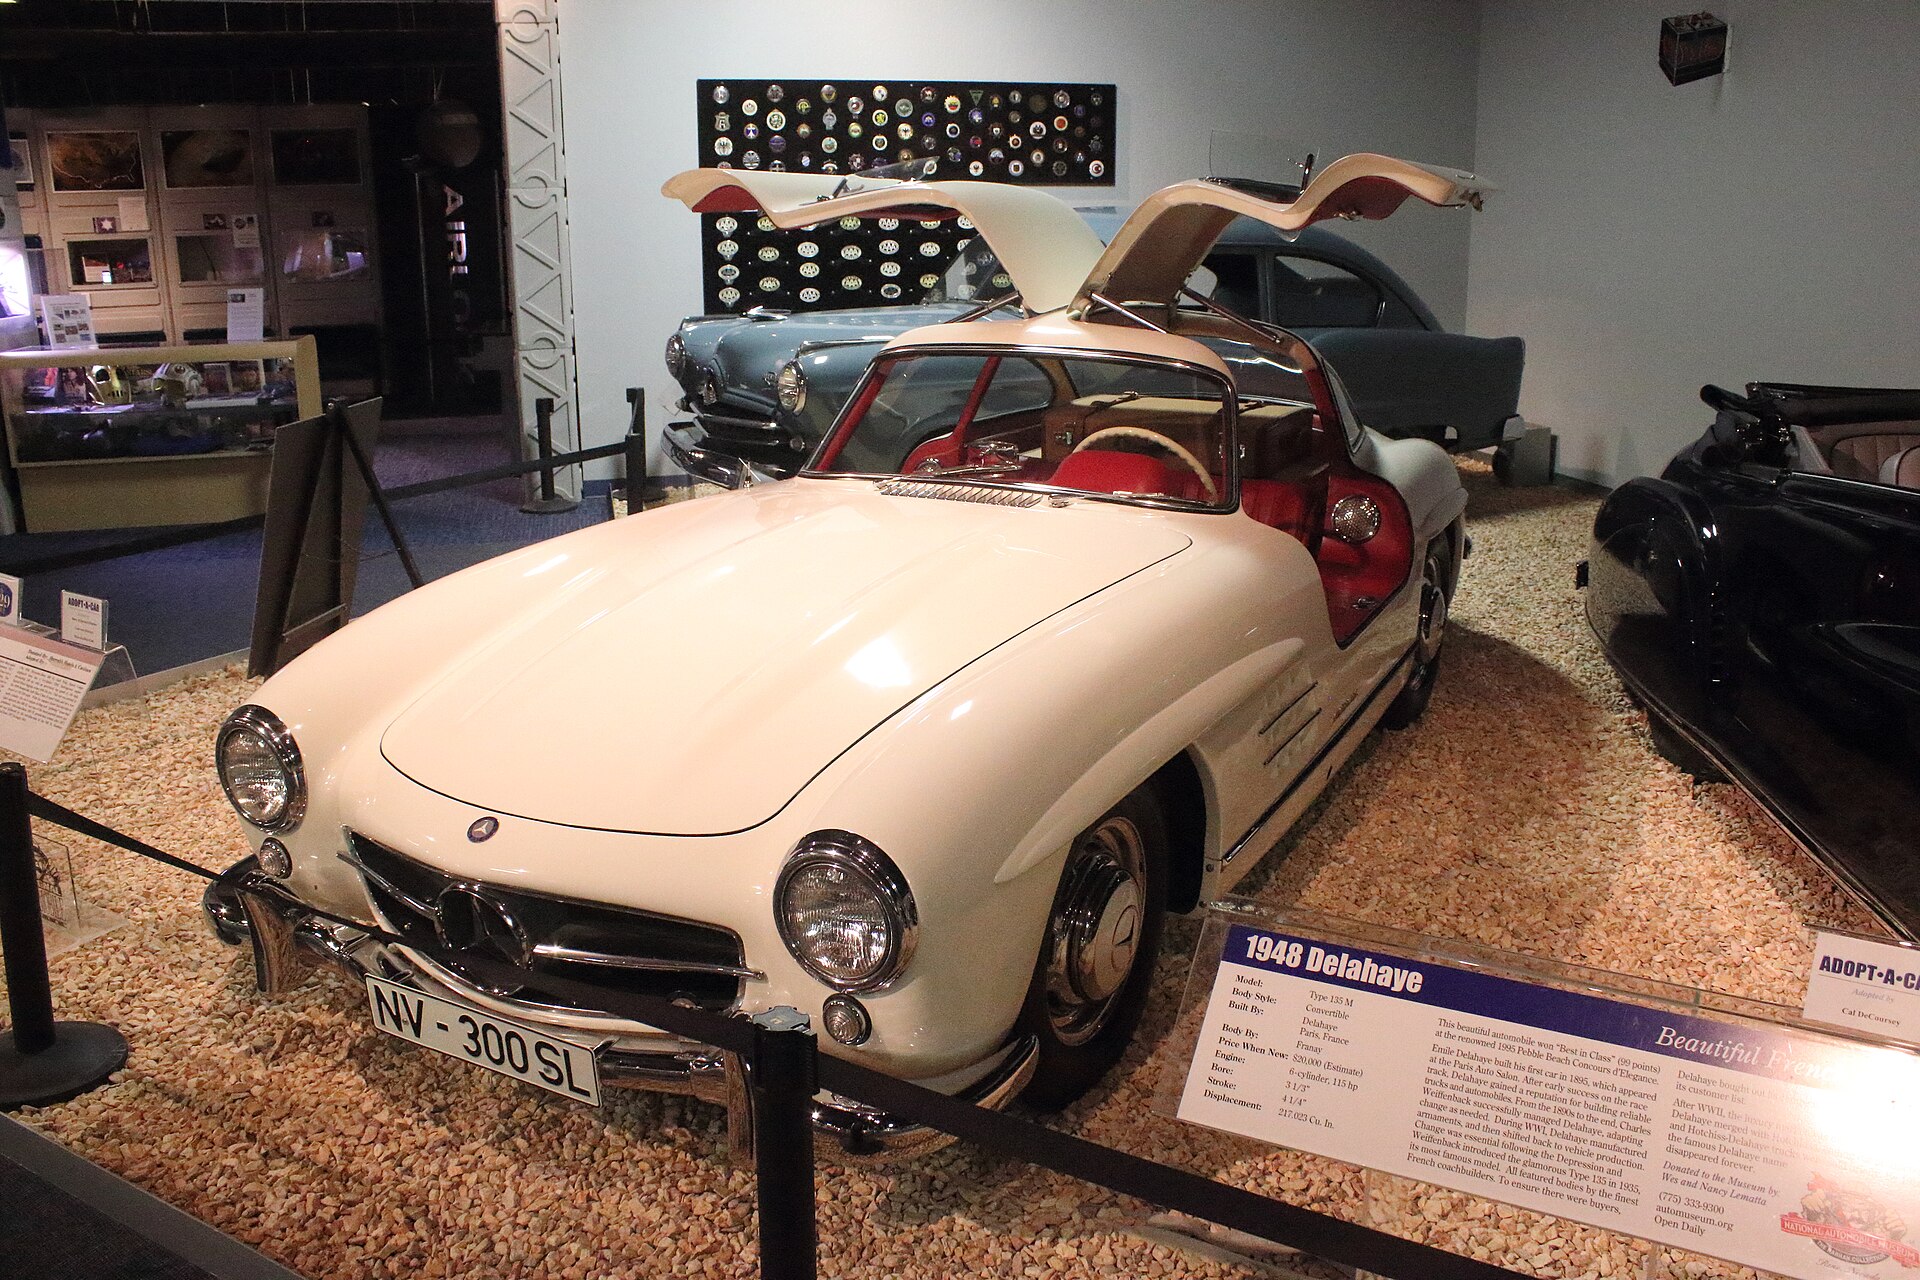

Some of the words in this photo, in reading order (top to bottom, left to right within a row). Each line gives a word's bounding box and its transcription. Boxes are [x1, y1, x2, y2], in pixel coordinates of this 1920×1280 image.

[1246, 934, 1304, 969] 1948
[1305, 946, 1424, 994] Delahaye
[1235, 974, 1264, 987] Model:
[1231, 987, 1252, 1000] Body
[1254, 992, 1277, 1004] Style:
[1309, 990, 1329, 1002] Type
[1329, 995, 1344, 1005] 135
[1344, 997, 1354, 1007] M
[374, 984, 424, 1039] NV
[1228, 1000, 1249, 1012] Built
[1250, 1004, 1264, 1016] By:
[1305, 1003, 1350, 1020] Convertible
[1841, 1007, 1856, 1017] Cal
[1221, 1023, 1242, 1036] Body
[1244, 1028, 1259, 1040] By:
[1302, 1016, 1338, 1032] Delahaye
[1218, 1036, 1240, 1048] Price
[1242, 1041, 1266, 1055] When
[1267, 1047, 1289, 1060] New:
[1295, 1040, 1323, 1055] Franay
[1322, 1032, 1350, 1046] France
[1438, 1017, 1456, 1029] This
[1456, 1021, 1491, 1037] beautiful
[1491, 1031, 1536, 1046] automobile
[1536, 1041, 1554, 1051] won
[1578, 1048, 1588, 1058] in
[1616, 1057, 1632, 1067] (99
[1631, 1062, 1661, 1074] points)
[1655, 1025, 1761, 1066] Beautiful
[1214, 1049, 1246, 1064] Engine:
[1434, 1030, 1444, 1038] at
[1443, 1030, 1457, 1041] the
[1457, 1035, 1497, 1049] renowned
[1497, 1042, 1516, 1053] 1995
[1516, 1045, 1544, 1059] Pebble
[1545, 1052, 1571, 1066] Beach
[1571, 1058, 1611, 1074] Concours
[1210, 1062, 1234, 1075] Bore:
[1292, 1053, 1323, 1068] $20,000
[1323, 1061, 1364, 1077] (Estimate)
[1431, 1043, 1455, 1056] Emile
[1455, 1048, 1493, 1065] Delahaye
[1493, 1056, 1513, 1069] built
[1513, 1061, 1526, 1072] his
[1526, 1064, 1544, 1076] first
[1544, 1071, 1559, 1079] car
[1558, 1071, 1568, 1082] in
[1592, 1080, 1618, 1093] which
[1618, 1087, 1658, 1102] appeared
[1206, 1076, 1237, 1090] Stroke:
[1284, 1080, 1292, 1089] 3
[1332, 1077, 1347, 1088] 115
[1347, 1080, 1359, 1092] hp
[1428, 1056, 1438, 1064] at
[1438, 1056, 1452, 1067] the
[1453, 1059, 1474, 1071] Paris
[1474, 1064, 1495, 1076] Auto
[1521, 1075, 1544, 1087] After
[1544, 1082, 1566, 1094] early
[1566, 1087, 1600, 1100] success
[1600, 1095, 1612, 1103] on
[1613, 1096, 1629, 1107] the
[1629, 1101, 1649, 1111] race
[1674, 1081, 1688, 1093] its
[1687, 1084, 1730, 1102] customer
[1676, 1070, 1718, 1089] Delahaye
[1718, 1078, 1752, 1096] bought
[1203, 1089, 1262, 1110] Displacement:
[1282, 1094, 1288, 1103] 4
[1451, 1070, 1489, 1087] Delahaye
[1489, 1081, 1518, 1093] gained
[1518, 1087, 1525, 1095] a
[1525, 1089, 1568, 1105] reputation
[1569, 1097, 1582, 1108] for
[1583, 1100, 1618, 1117] building
[1619, 1110, 1652, 1124] reliable
[1671, 1097, 1697, 1111] After
[1278, 1107, 1308, 1122] 217.023
[1670, 1108, 1714, 1129] Delahaye
[1713, 1118, 1750, 1137] merged
[1668, 1120, 1687, 1133] and
[1665, 1144, 1720, 1164] disappeared
[1666, 1131, 1684, 1144] the
[1683, 1135, 1718, 1152] famous
[1717, 1143, 1761, 1164] Delahaye
[1406, 1152, 1436, 1167] French
[1498, 1174, 1510, 1186] To
[1510, 1181, 1541, 1193] ensure
[1541, 1186, 1565, 1200] there
[1566, 1194, 1588, 1205] were
[1662, 1159, 1700, 1177] Donated
[1700, 1168, 1711, 1180] to
[1711, 1171, 1726, 1184] the
[1727, 1175, 1767, 1193] Museum
[1662, 1171, 1679, 1184] Wes
[1679, 1179, 1699, 1189] and
[1699, 1181, 1728, 1198] Nancy
[1729, 1189, 1767, 1206] Lematta
[1658, 1191, 1682, 1205] (775)
[1683, 1197, 1725, 1214] 333-9300
[1653, 1214, 1679, 1229] Open
[1681, 1220, 1706, 1237] Daily
[1655, 1205, 1734, 1231] automuseum.org
[1784, 1221, 1822, 1236] NATIONAL
